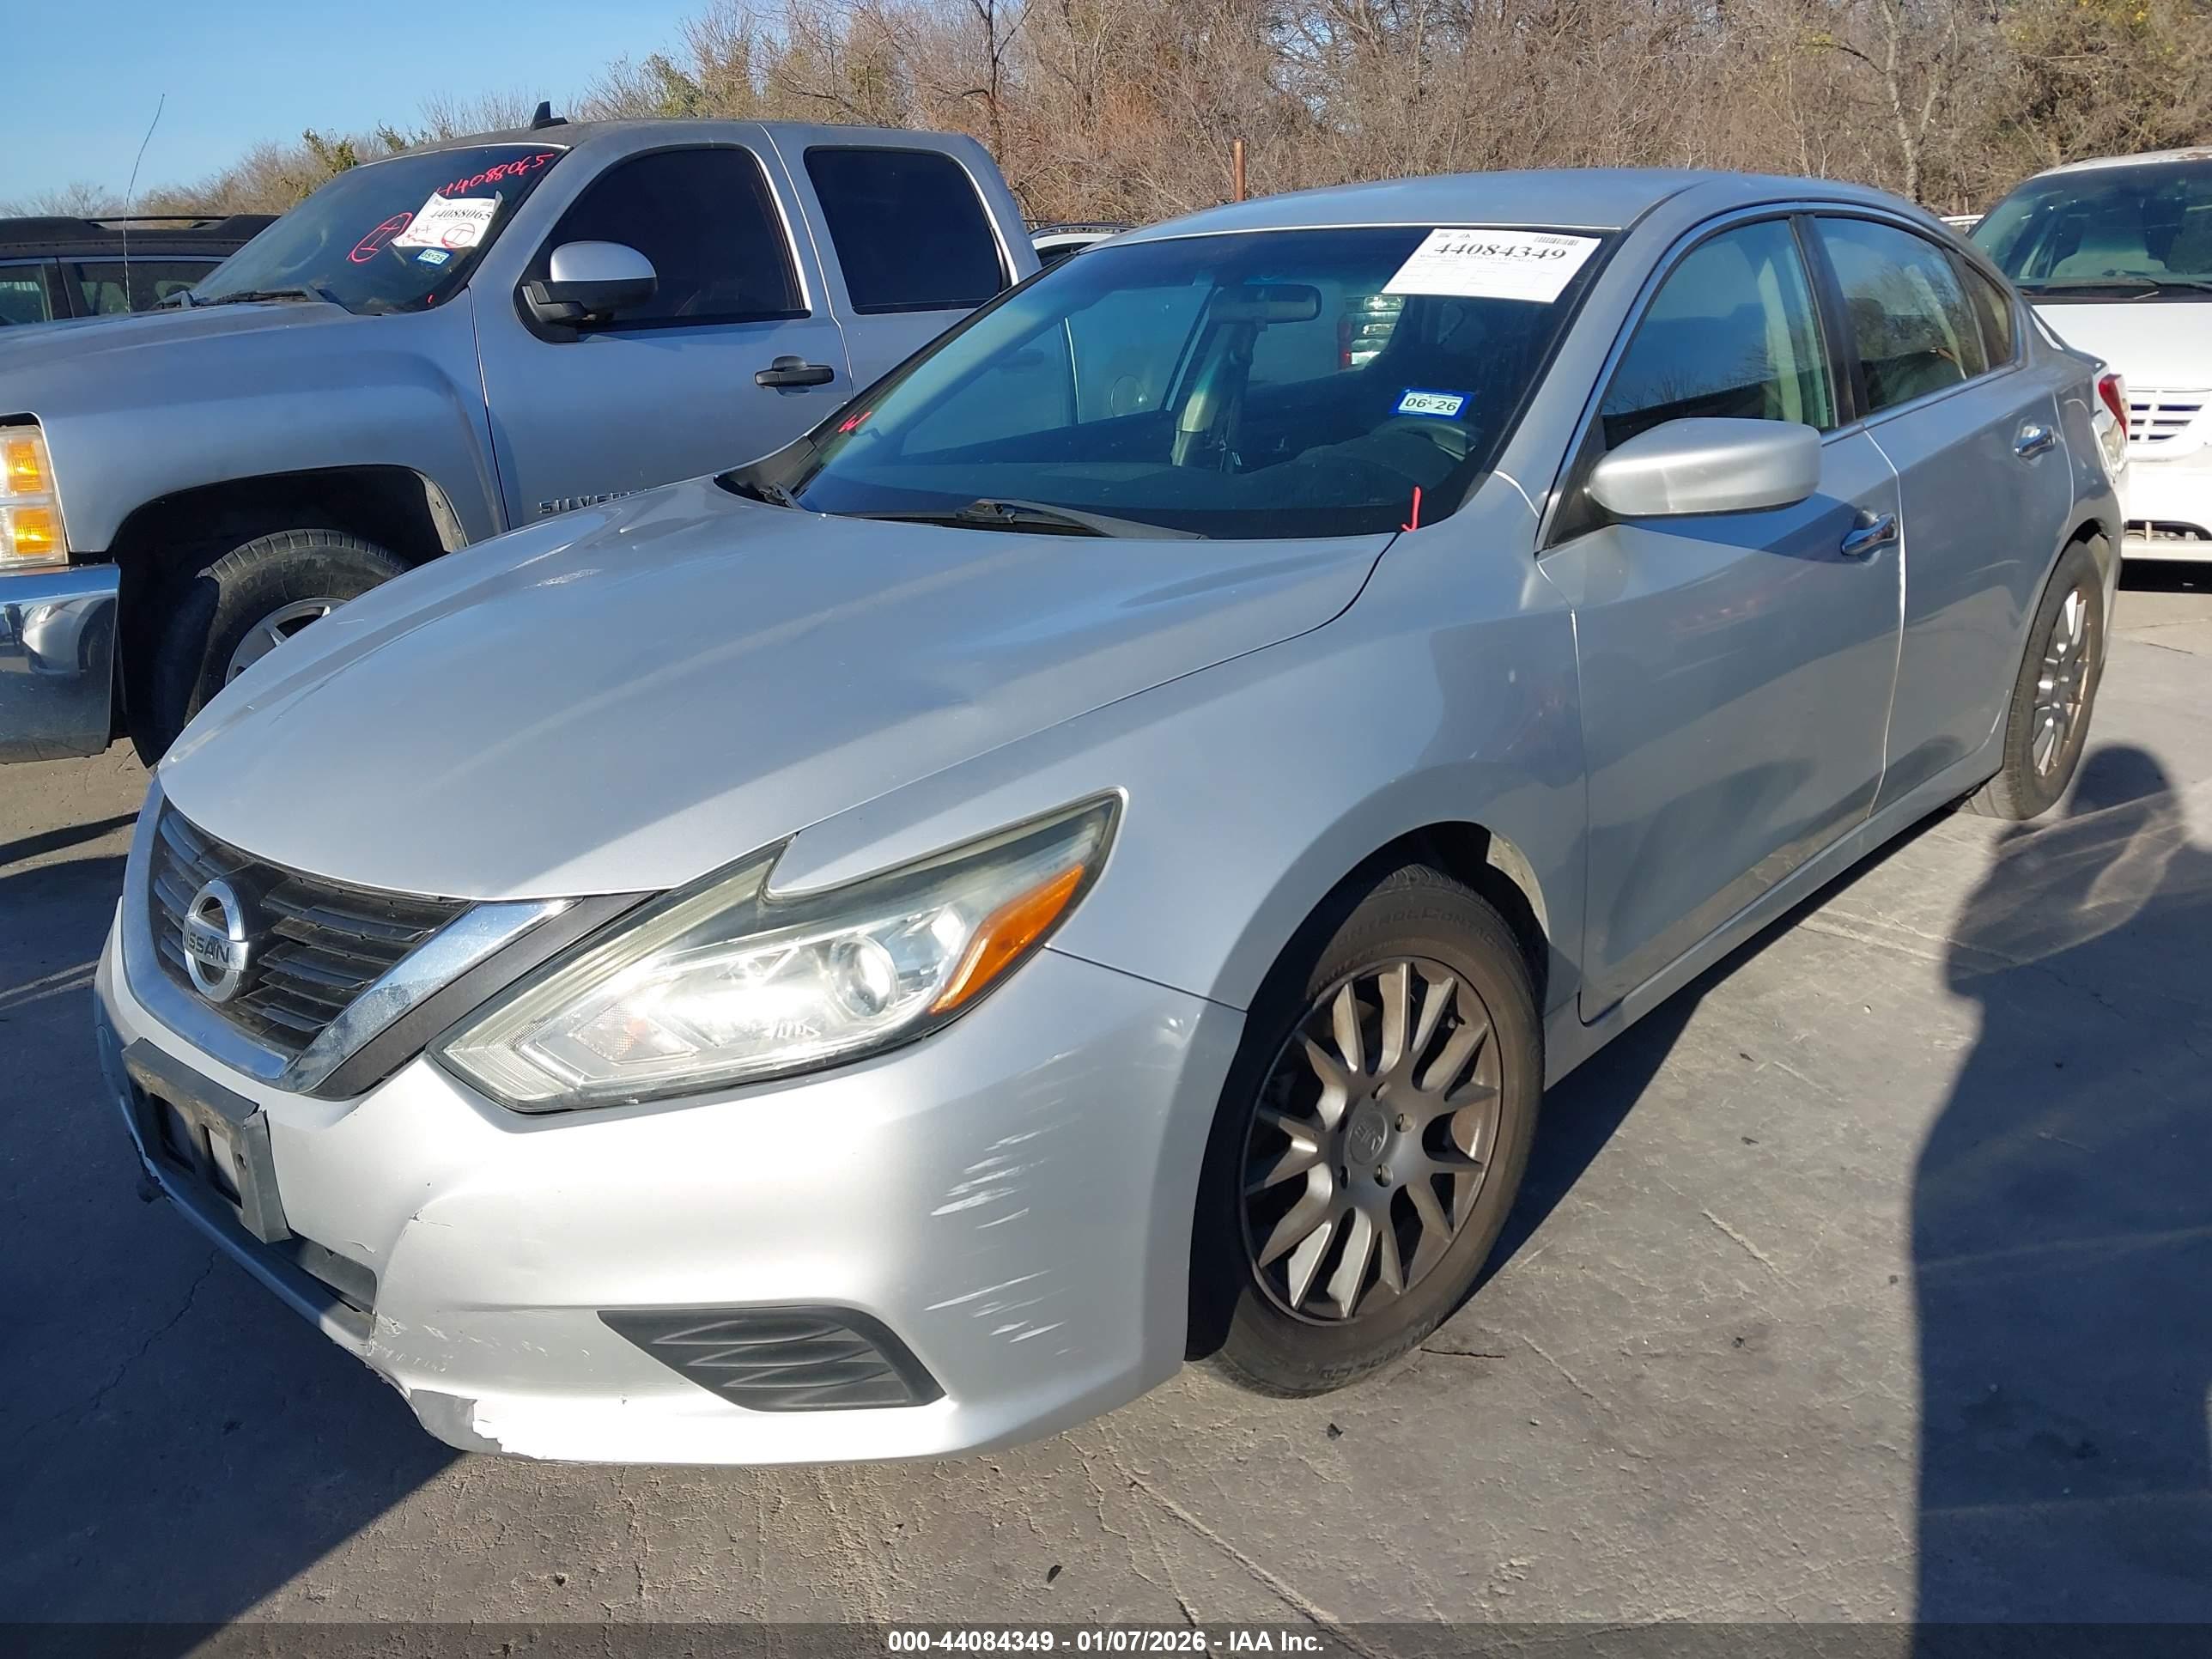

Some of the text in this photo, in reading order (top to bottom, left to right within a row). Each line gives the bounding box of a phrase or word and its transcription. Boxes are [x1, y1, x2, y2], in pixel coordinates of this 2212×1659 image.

[1435, 242, 1567, 261] 44084349
[1405, 398, 1458, 411] 06 26
